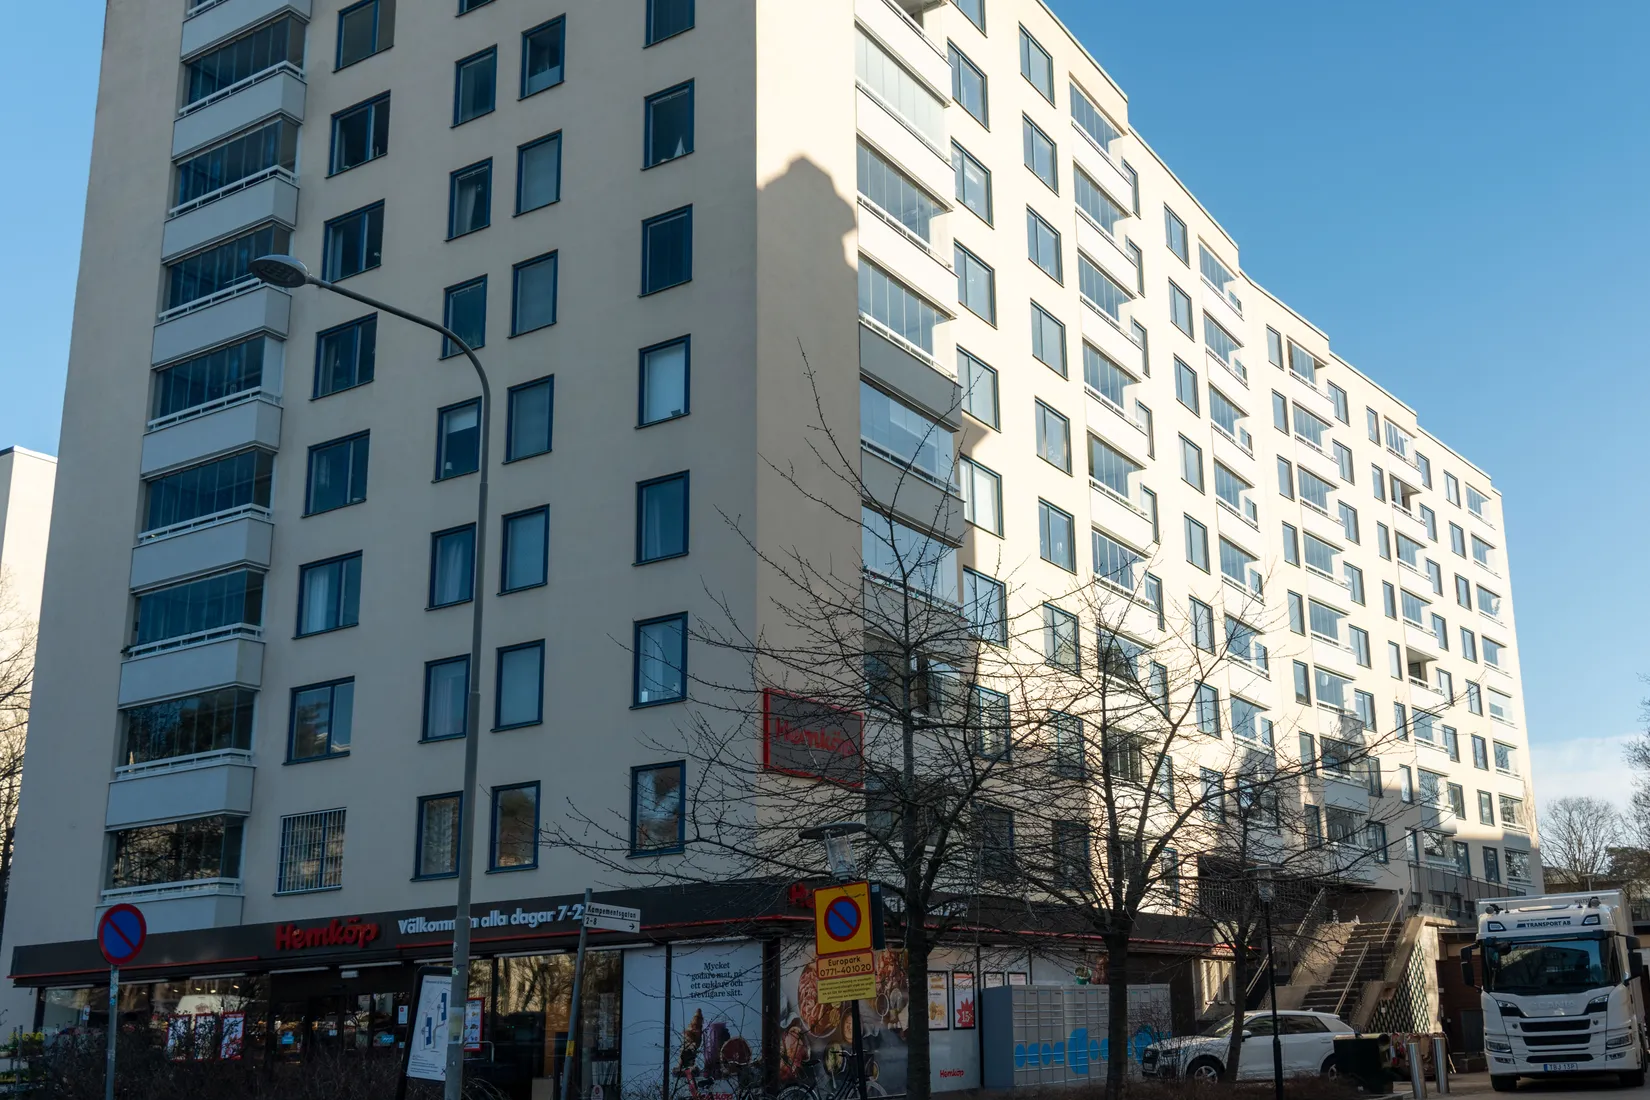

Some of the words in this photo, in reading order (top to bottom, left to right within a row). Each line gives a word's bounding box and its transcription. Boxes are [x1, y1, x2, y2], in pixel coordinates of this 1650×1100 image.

[587, 905, 637, 919] Kampementsgatan
[398, 916, 480, 935] Välkommn
[481, 909, 509, 928] alla
[510, 907, 556, 929] dagar
[557, 903, 585, 922] 7-2
[585, 917, 598, 926] 2-8
[1526, 920, 1561, 929] TRANSPORT
[1562, 919, 1572, 927] AB
[275, 916, 380, 951] Hemköp
[703, 962, 730, 971] Mycket
[828, 956, 861, 967] Europark
[820, 964, 872, 977] 0771-401020
[691, 972, 715, 982] godare
[702, 980, 729, 988] enklare
[730, 979, 743, 987] och
[690, 989, 726, 1000] trevligare
[726, 989, 743, 997] sätt.
[939, 1068, 965, 1079] Hemköp
